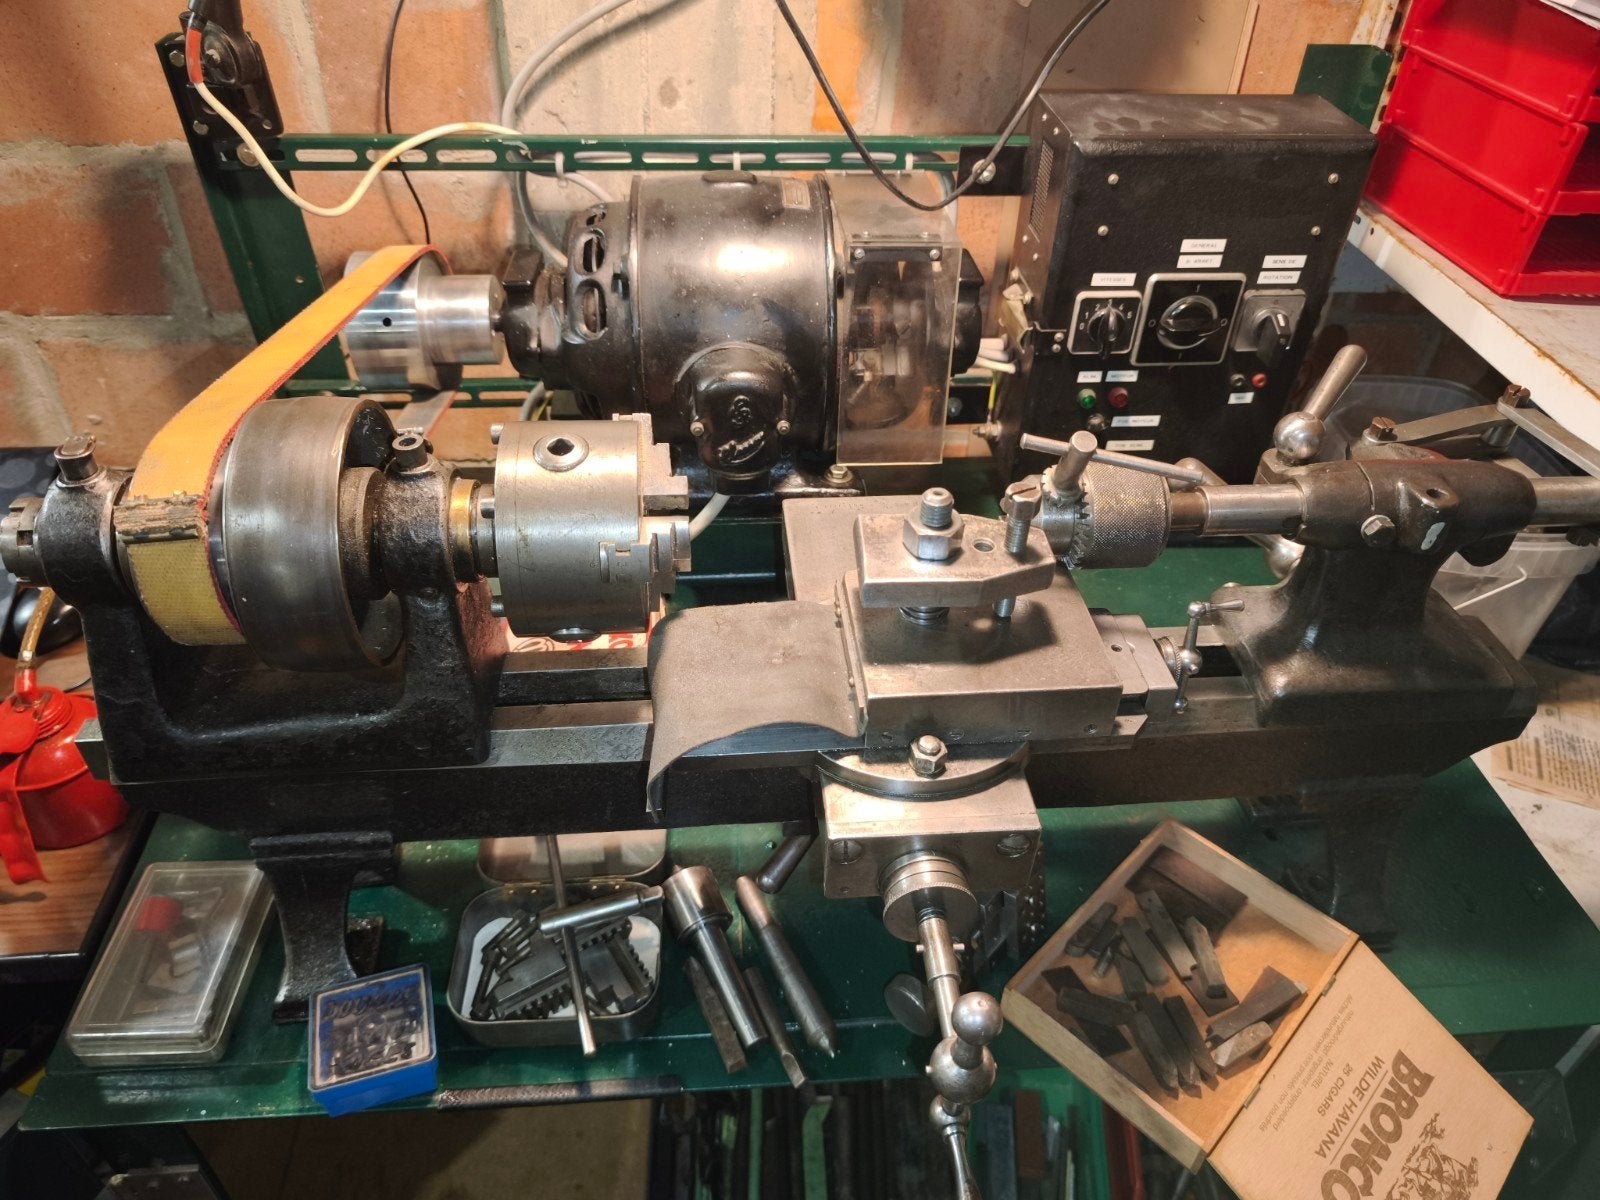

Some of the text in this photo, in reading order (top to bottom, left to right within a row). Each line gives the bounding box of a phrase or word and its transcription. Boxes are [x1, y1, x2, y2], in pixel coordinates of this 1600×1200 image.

[1314, 1056, 1385, 1159] WILDE HAVANA
[1317, 1062, 1353, 1117] 25 CIGARS
[1321, 1049, 1435, 1200] BRONCO
